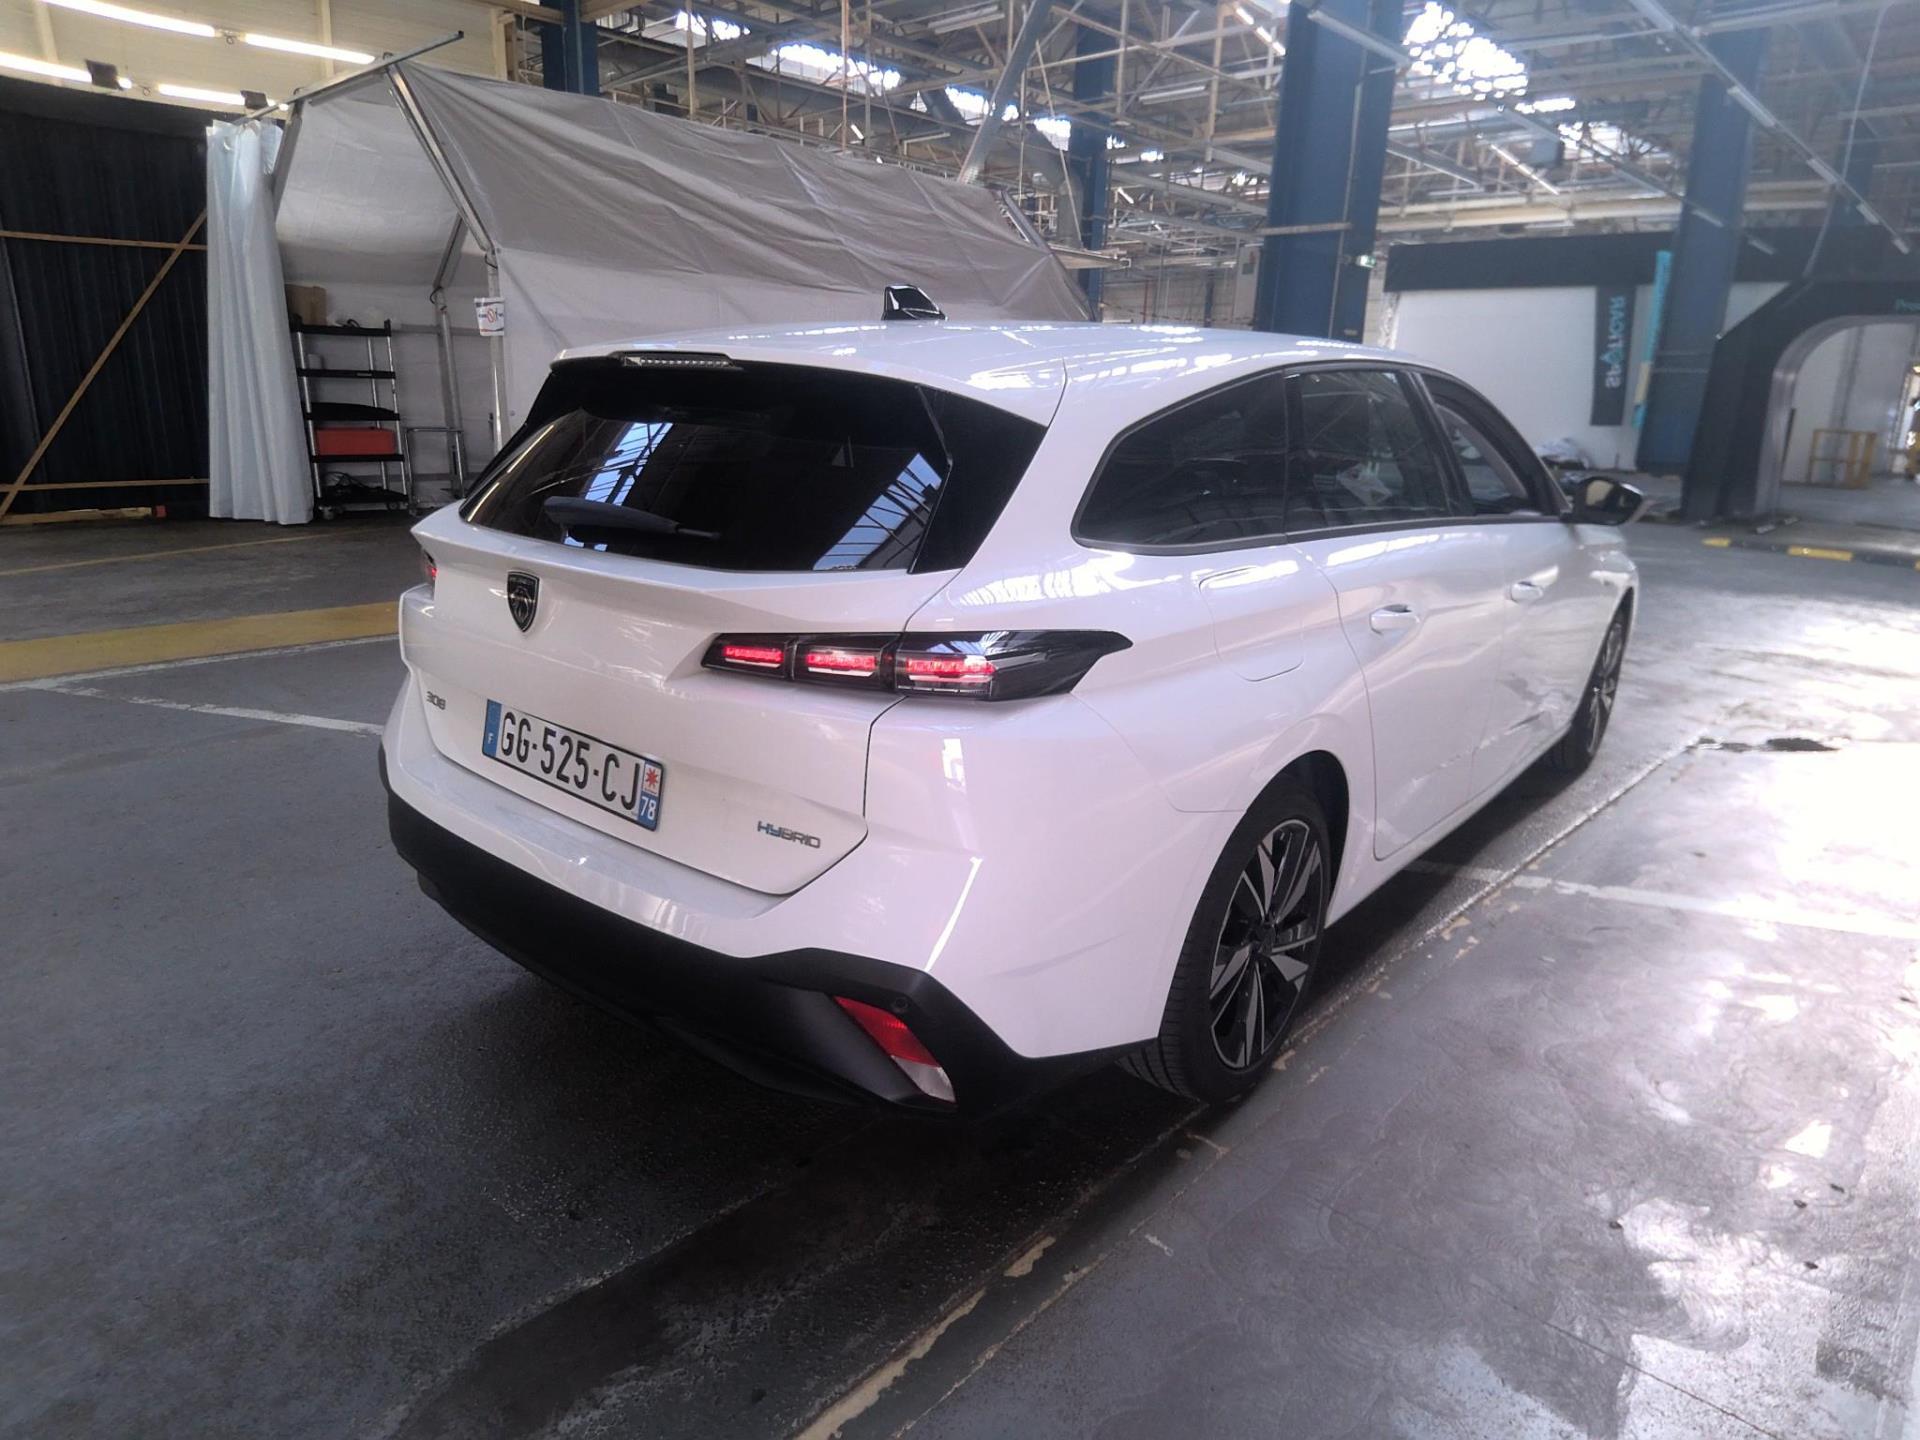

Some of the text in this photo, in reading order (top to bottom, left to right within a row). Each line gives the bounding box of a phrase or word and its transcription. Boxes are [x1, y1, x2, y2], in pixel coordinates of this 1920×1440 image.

[426, 691, 446, 710] 308
[501, 711, 640, 810] GG-525-CJ
[640, 795, 657, 820] 78
[757, 820, 821, 849] HYBRID
